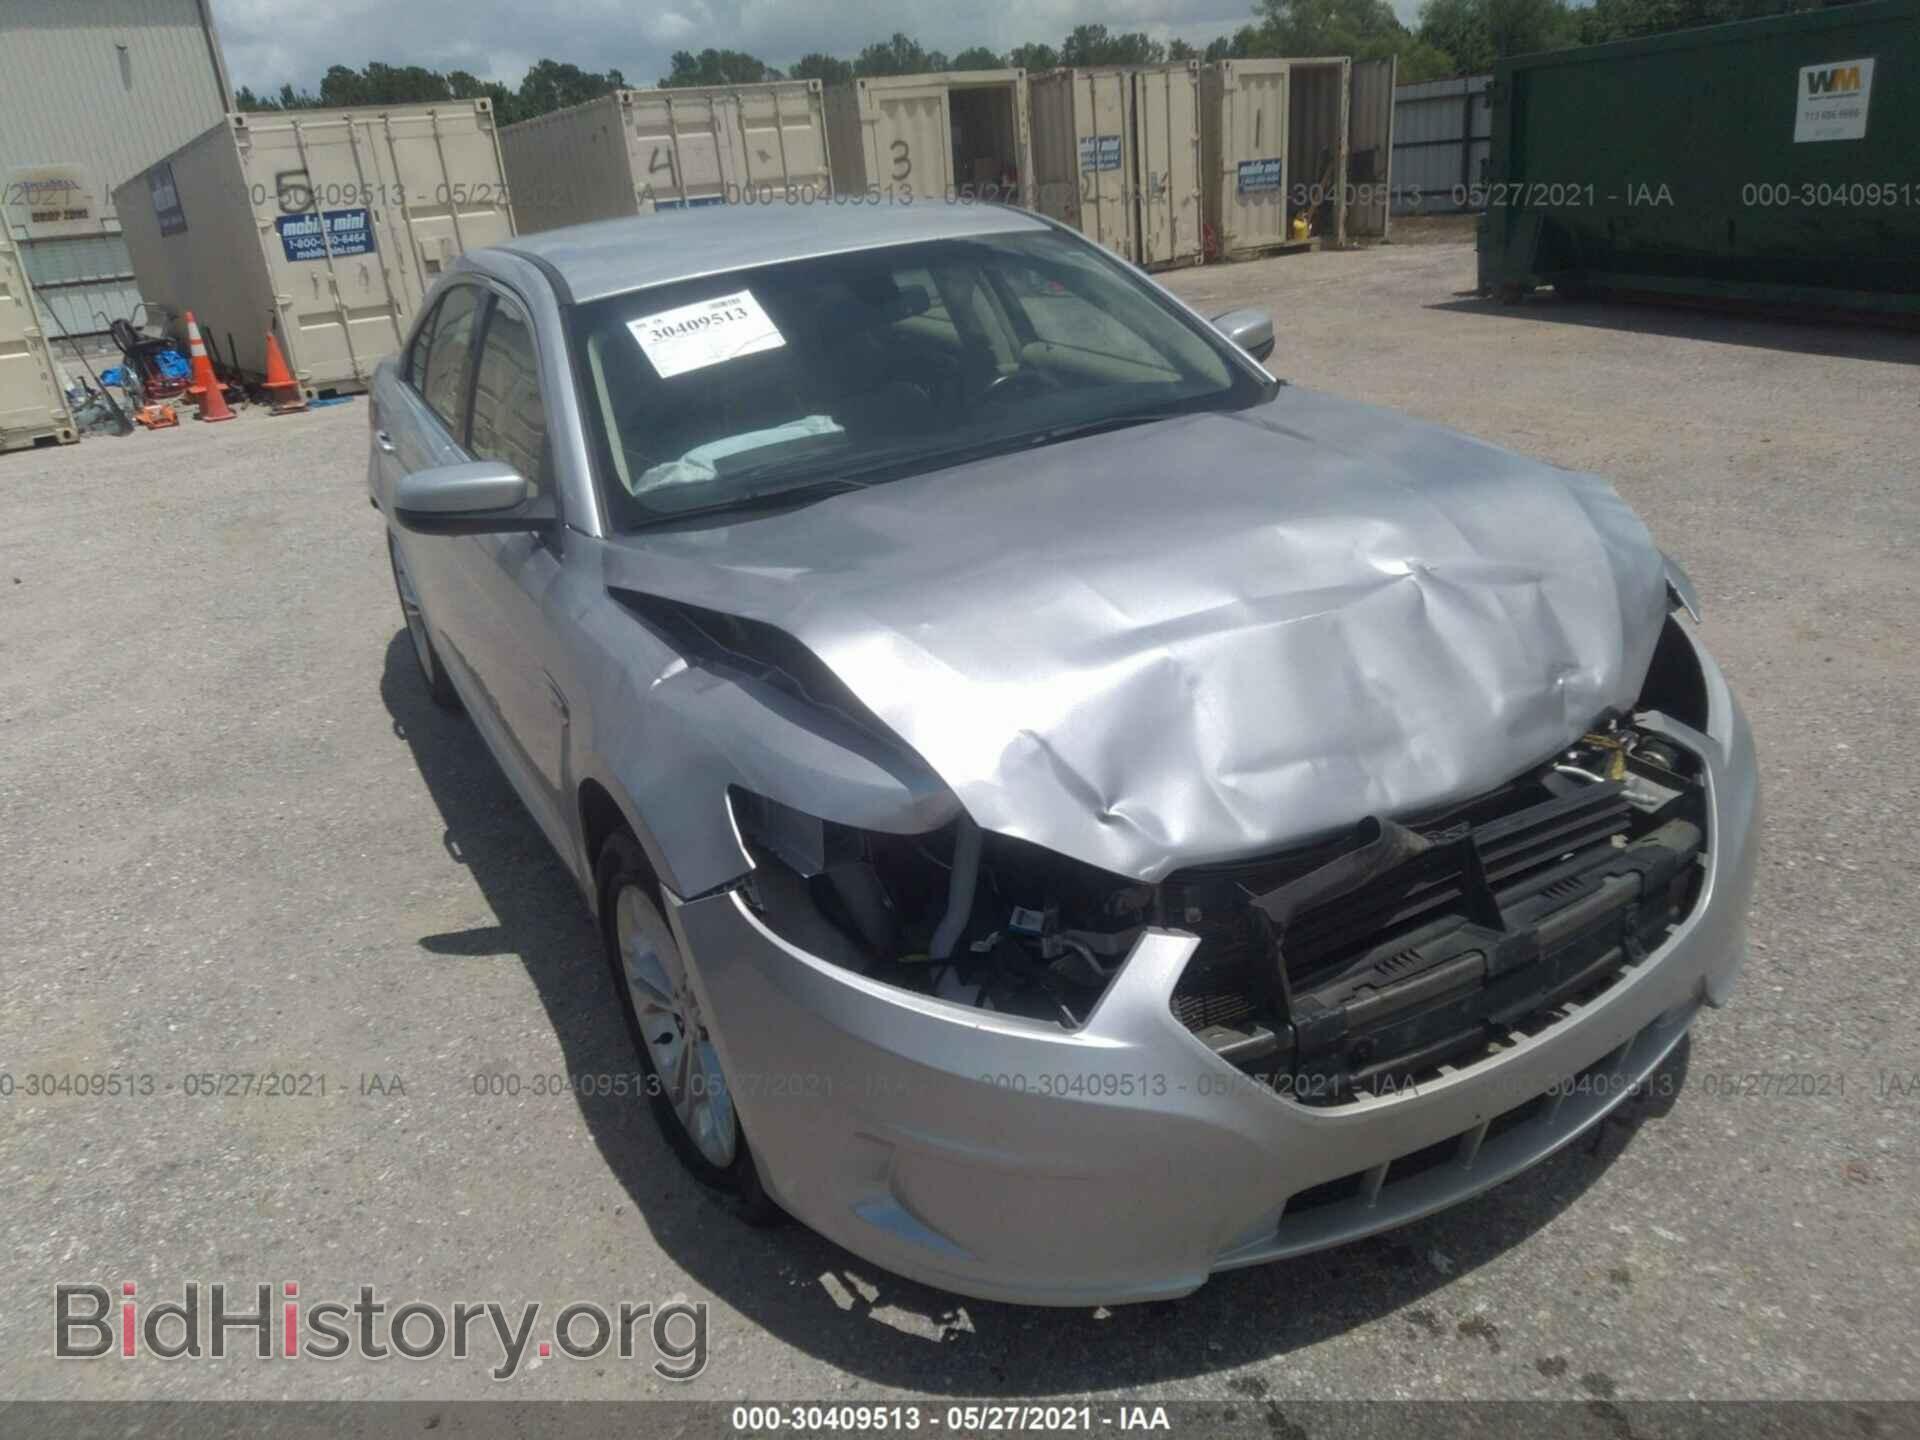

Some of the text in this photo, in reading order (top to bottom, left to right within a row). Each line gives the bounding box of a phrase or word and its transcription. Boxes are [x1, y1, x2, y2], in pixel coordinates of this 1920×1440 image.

[1806, 67, 1861, 94] WM
[648, 144, 678, 188] 4
[889, 139, 913, 182] 3
[275, 168, 314, 214] 5
[334, 213, 365, 231] mini
[650, 306, 749, 343] 30409513
